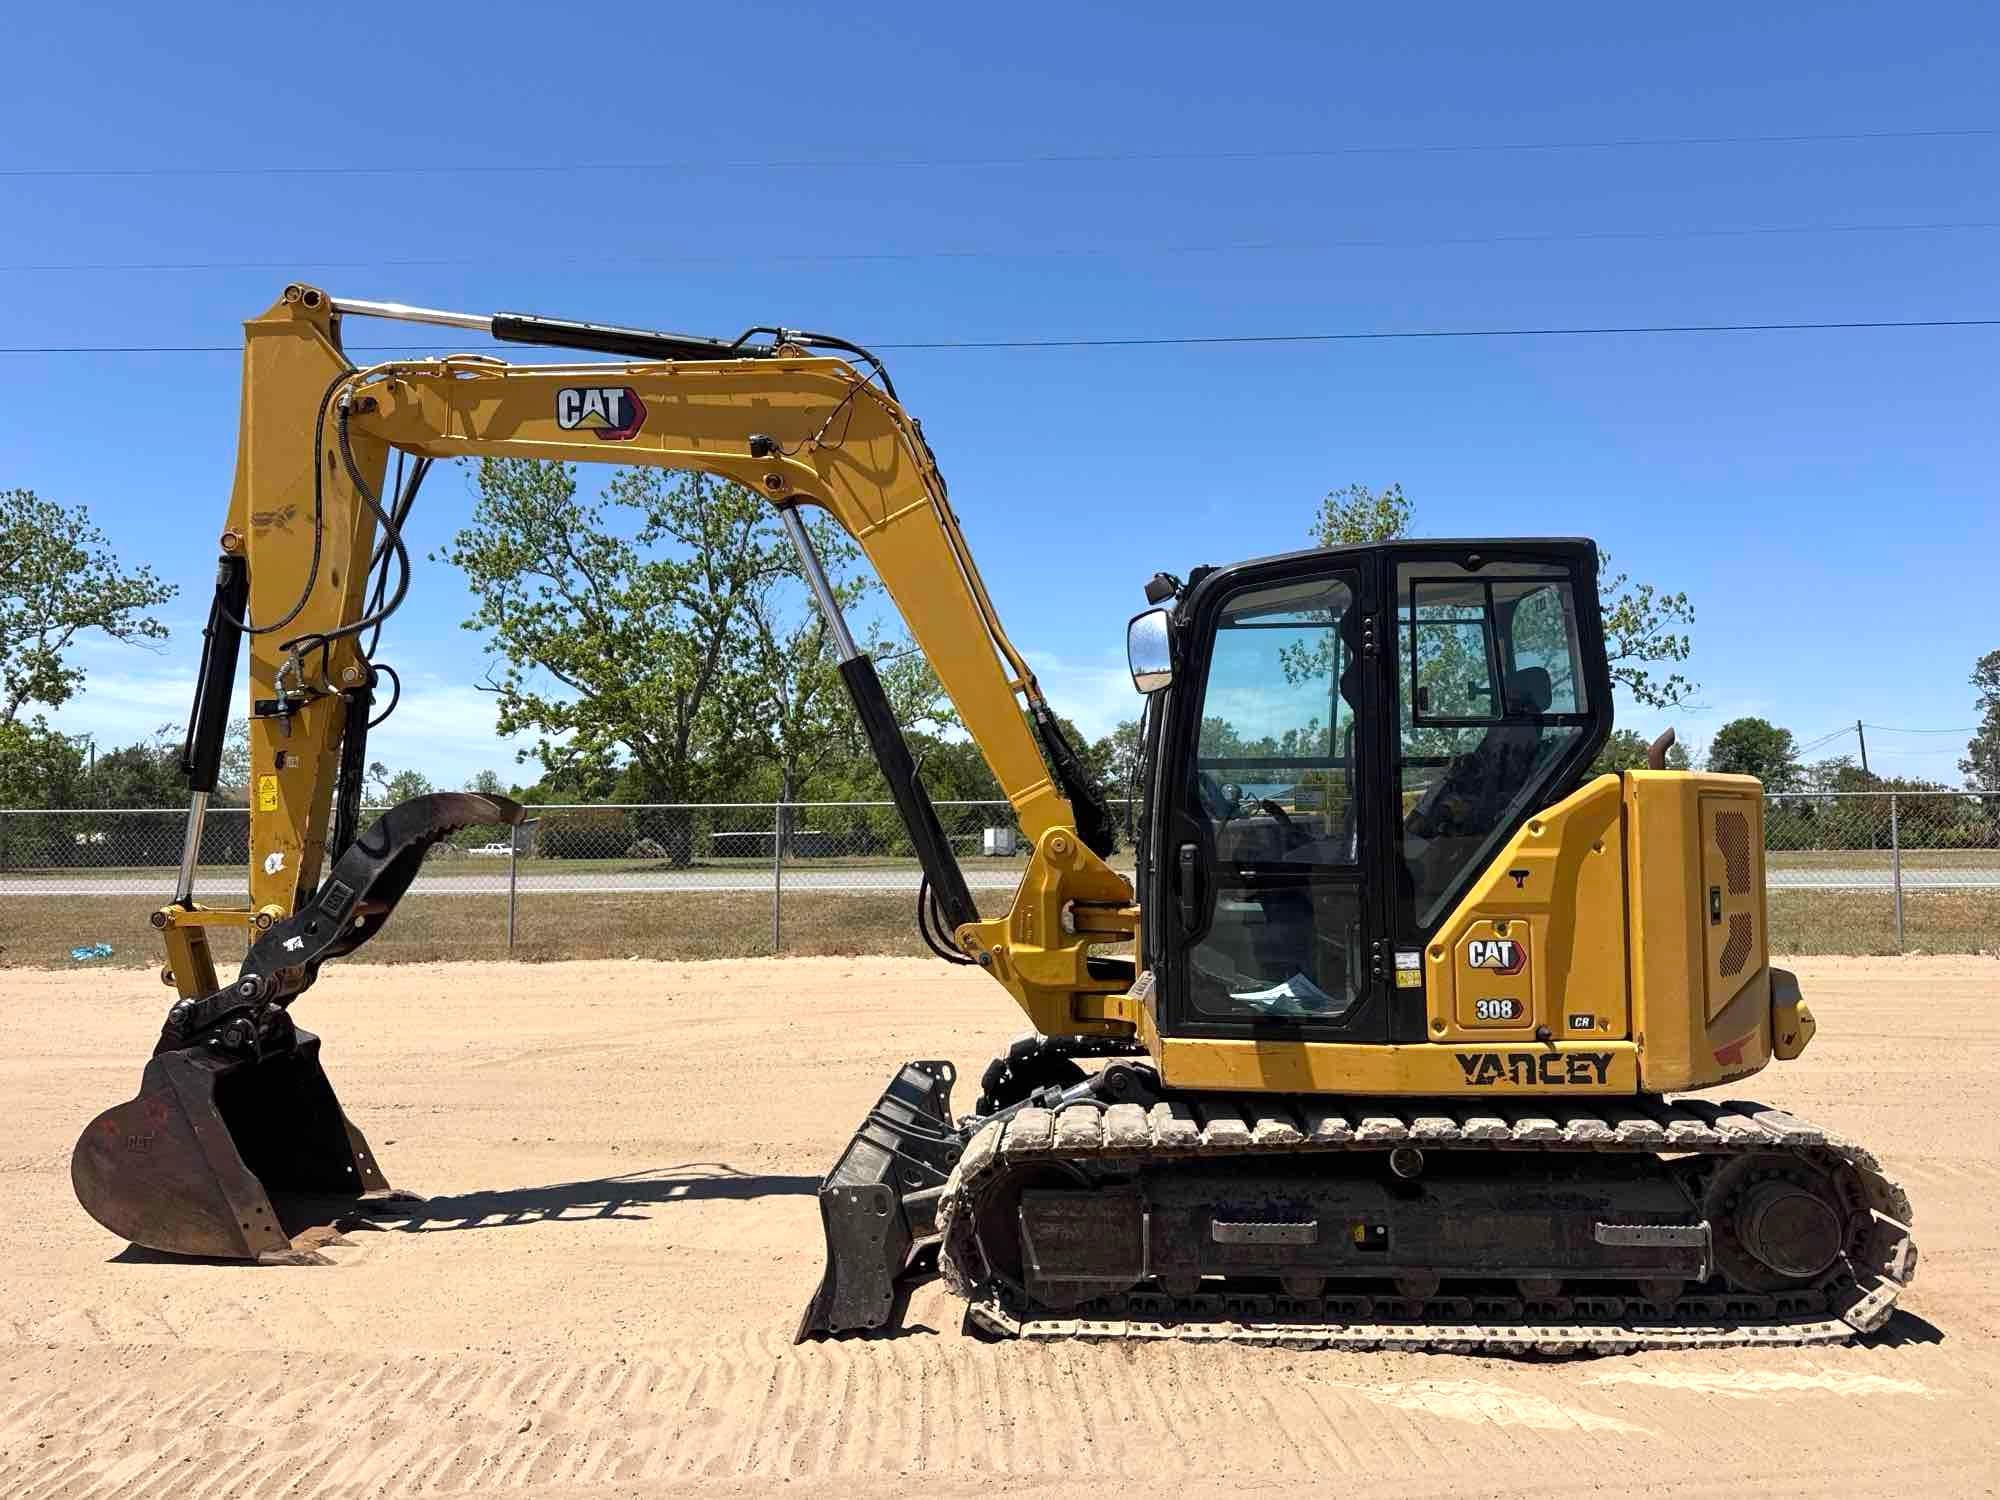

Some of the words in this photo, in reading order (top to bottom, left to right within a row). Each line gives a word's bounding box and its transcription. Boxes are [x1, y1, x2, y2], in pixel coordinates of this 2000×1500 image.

[557, 387, 625, 430] CAT
[1468, 940, 1513, 968] CAT
[1476, 999, 1513, 1020] 308
[1574, 1016, 1590, 1028] CR
[1455, 1052, 1615, 1086] YANCEY
